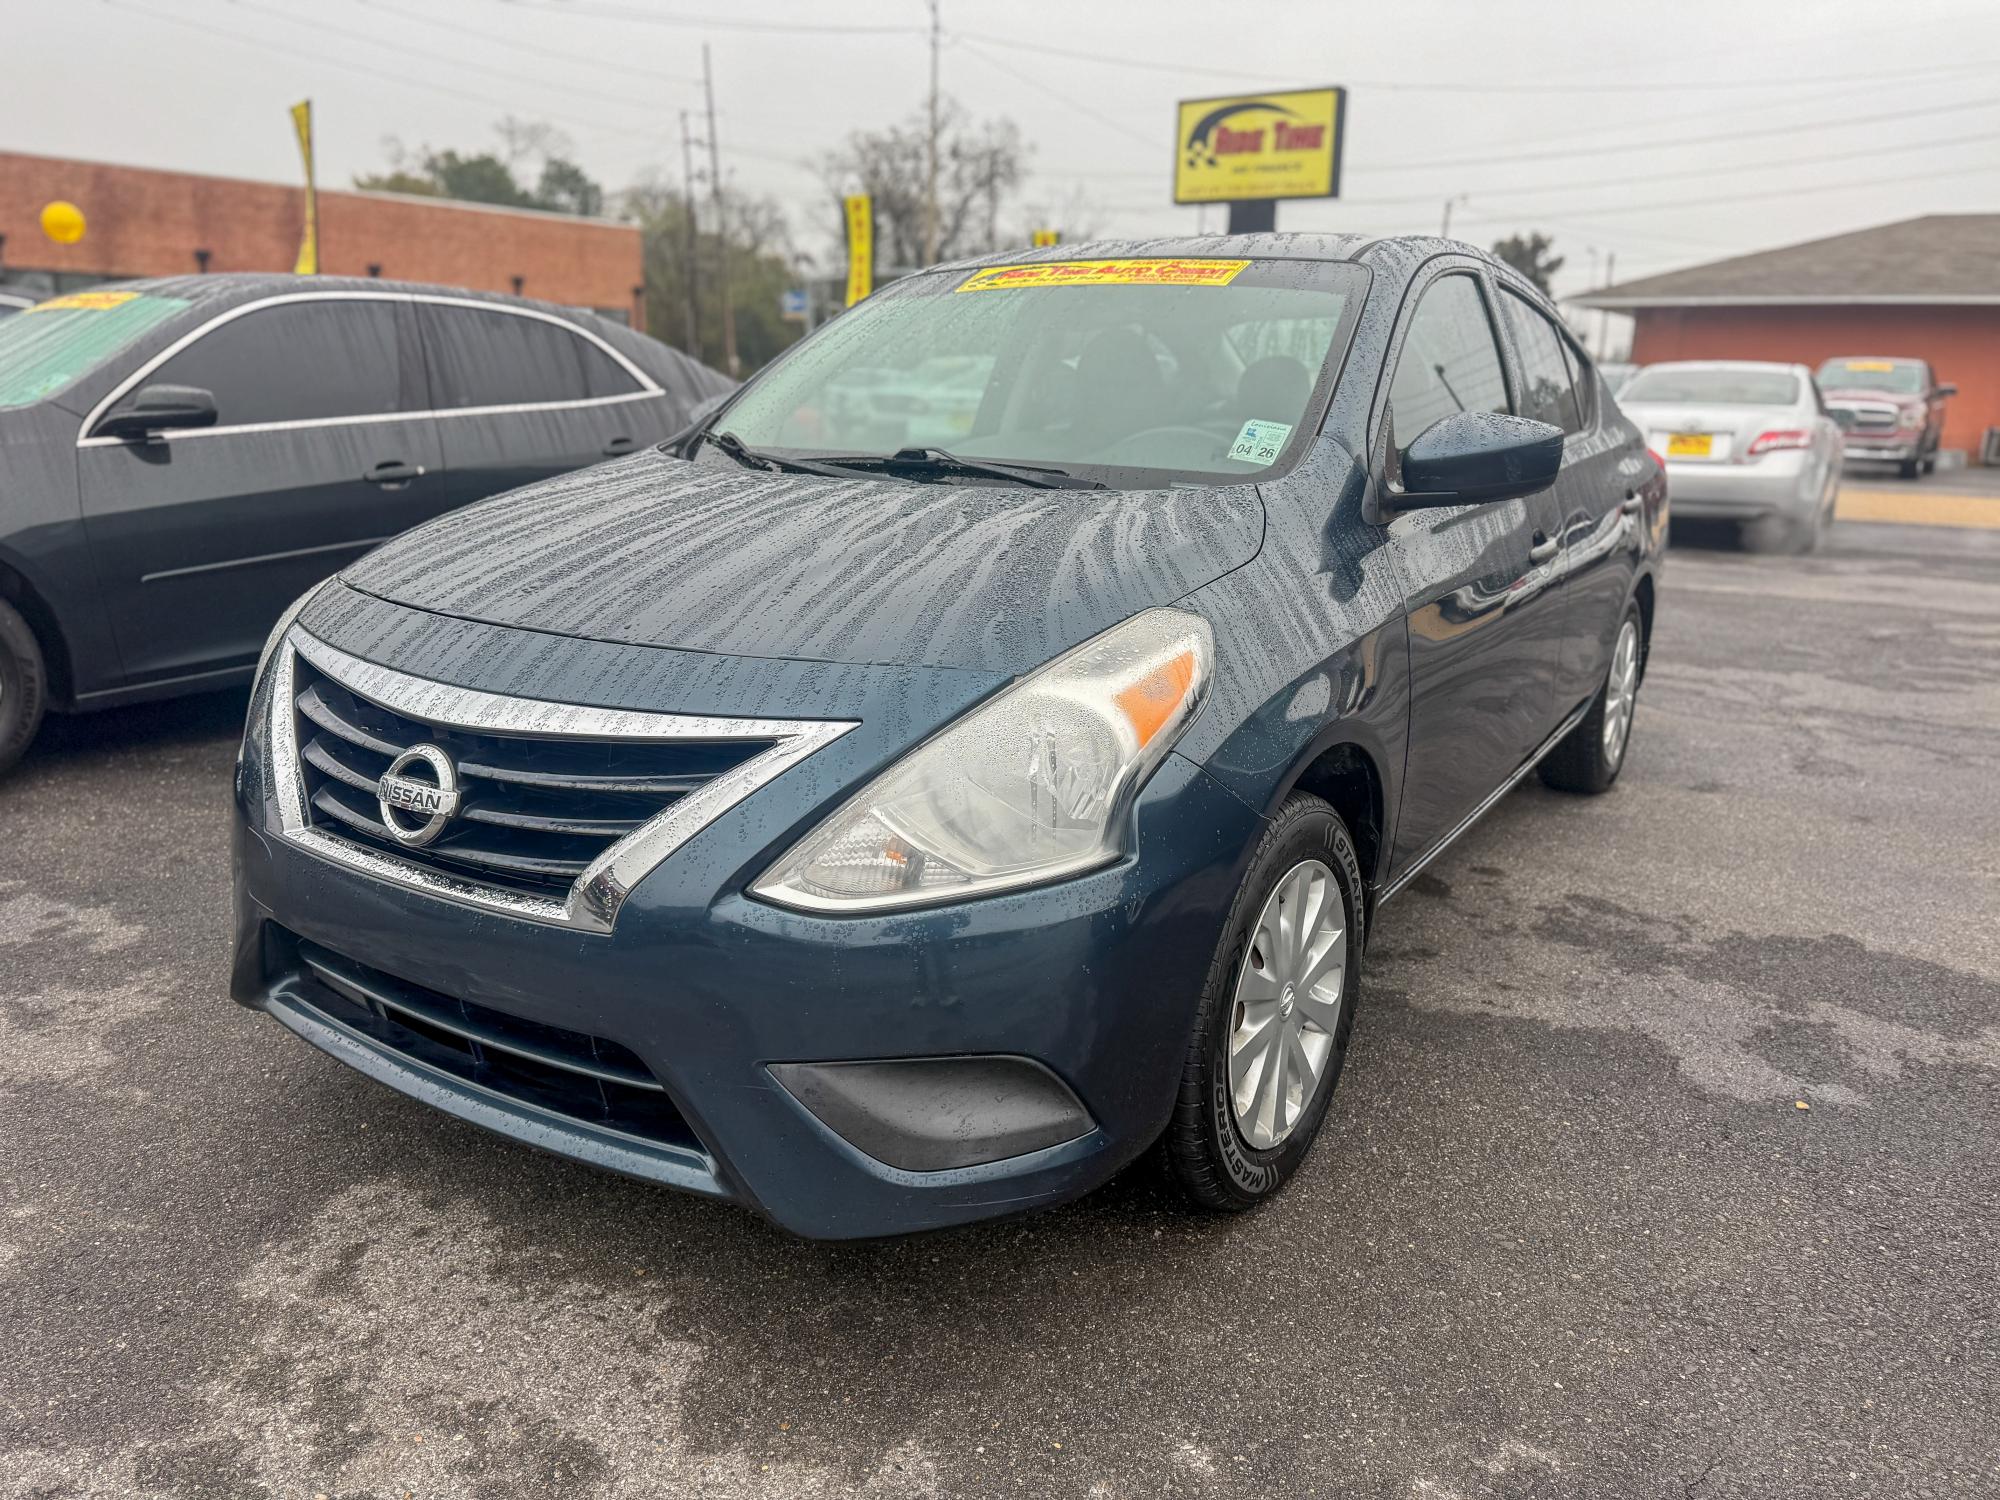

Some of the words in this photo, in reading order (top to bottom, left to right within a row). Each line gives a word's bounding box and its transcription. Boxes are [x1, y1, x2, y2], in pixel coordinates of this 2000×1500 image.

[1236, 444, 1253, 455] 04
[1258, 447, 1275, 459] 26
[381, 780, 442, 810] NISSAN
